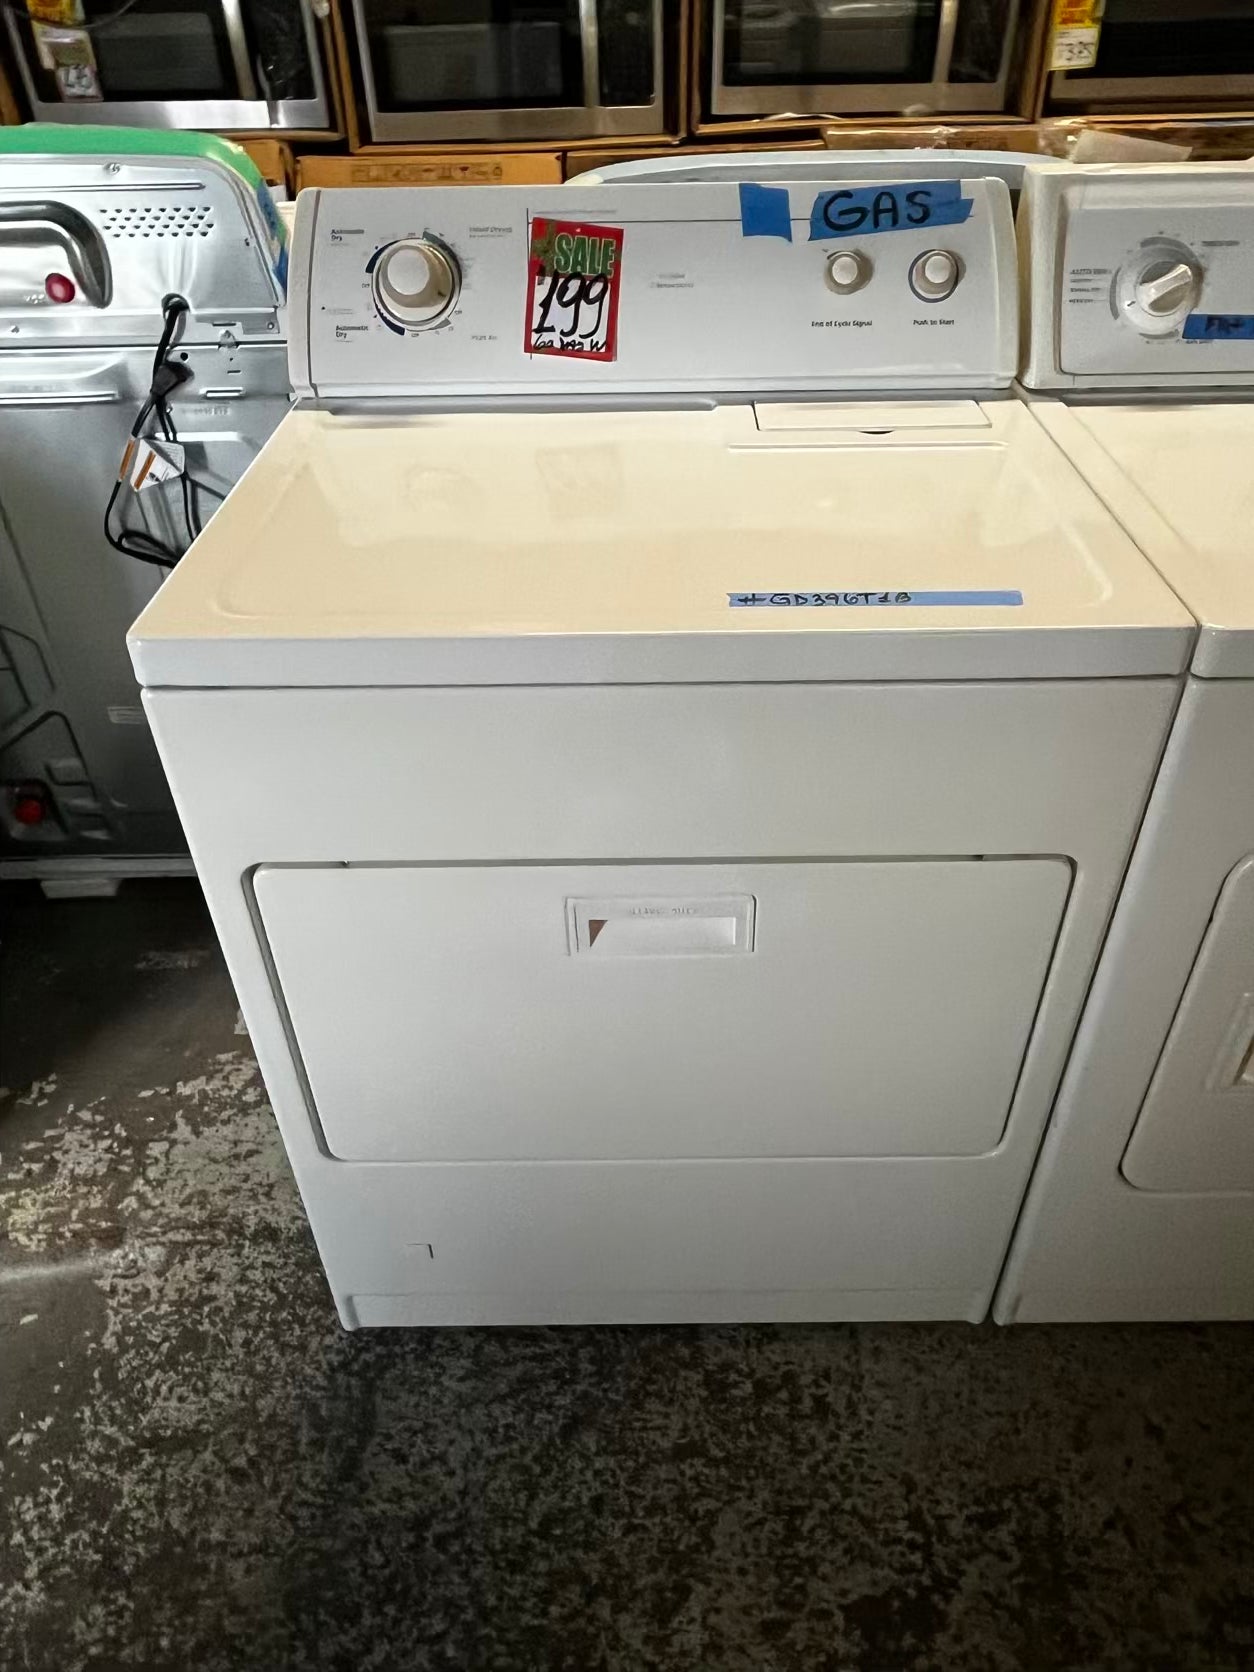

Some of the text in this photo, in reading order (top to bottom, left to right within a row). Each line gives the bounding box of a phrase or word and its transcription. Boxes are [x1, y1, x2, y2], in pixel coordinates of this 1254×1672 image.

[823, 189, 932, 232] GAS
[554, 232, 616, 278] SALE
[531, 268, 610, 339] 199
